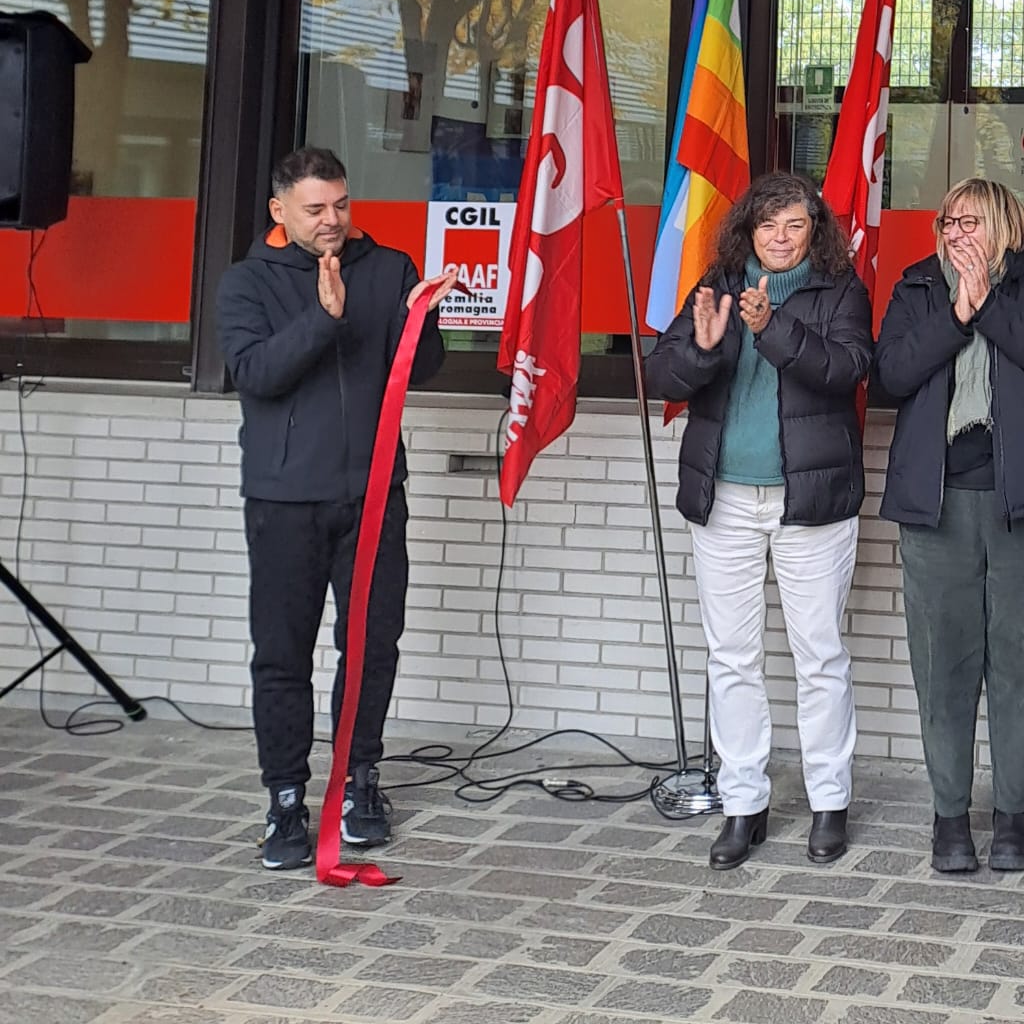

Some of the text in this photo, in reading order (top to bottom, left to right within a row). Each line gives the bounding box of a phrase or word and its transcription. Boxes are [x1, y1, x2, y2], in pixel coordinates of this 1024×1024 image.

[445, 206, 500, 226] CGIL
[444, 292, 494, 304] emilia
[440, 305, 497, 316] romagna
